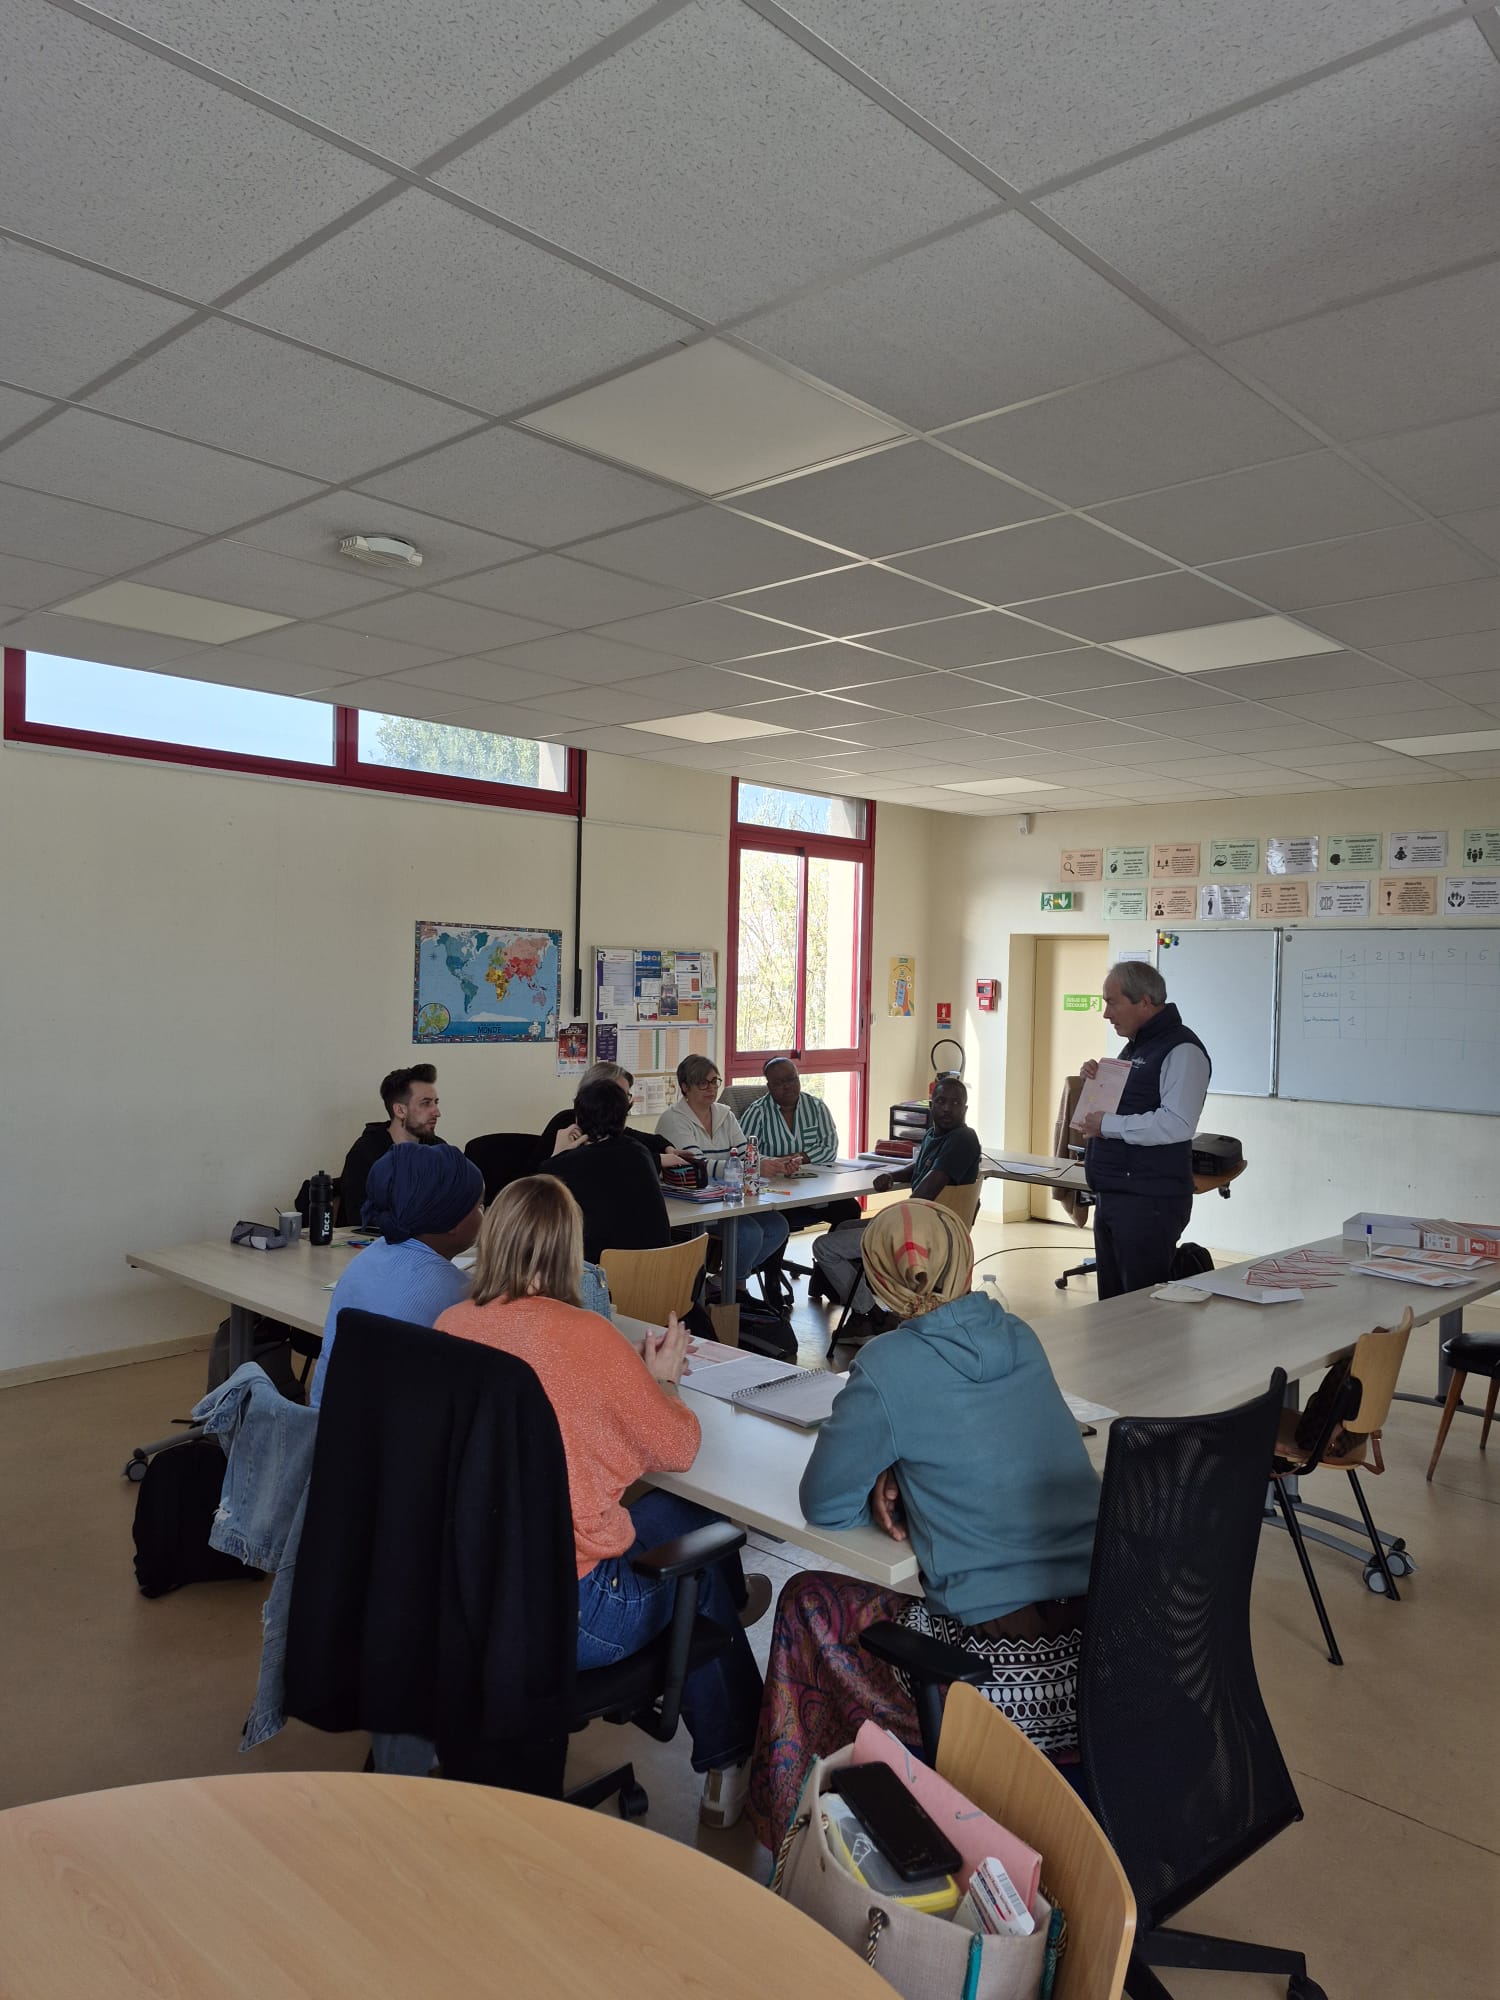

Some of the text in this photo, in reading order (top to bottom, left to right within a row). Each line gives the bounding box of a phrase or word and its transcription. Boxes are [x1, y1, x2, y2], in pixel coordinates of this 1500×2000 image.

[1346, 948, 1488, 962] 1 2 3 4 5 6
[477, 1026, 502, 1034] MONDE
[321, 1211, 330, 1237] Tacx
